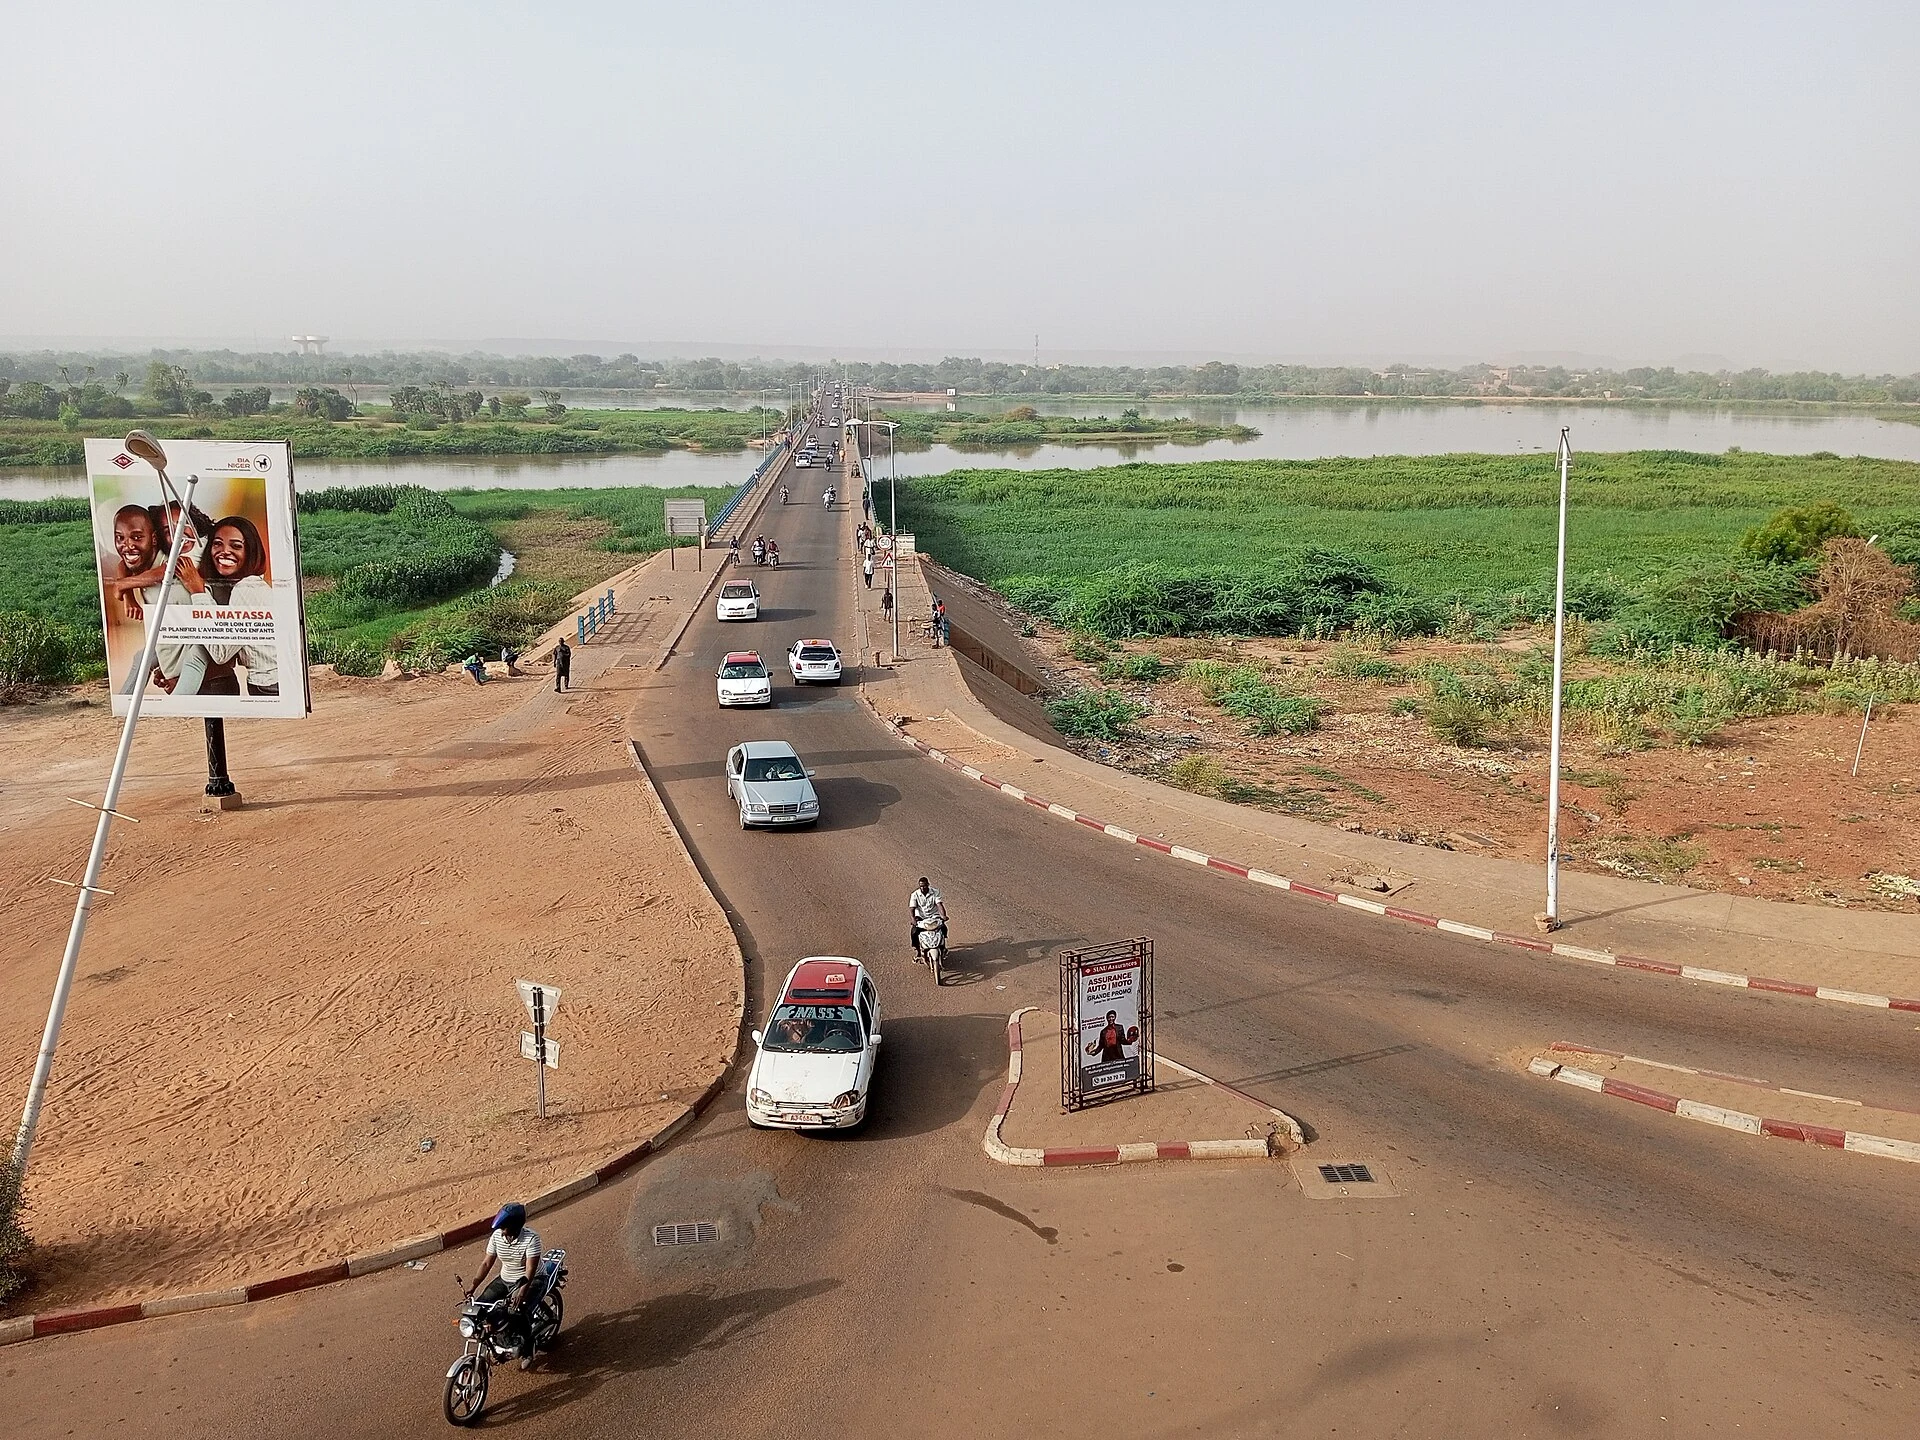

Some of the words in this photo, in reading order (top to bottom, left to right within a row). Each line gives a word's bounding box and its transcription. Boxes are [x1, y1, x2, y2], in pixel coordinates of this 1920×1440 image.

[192, 610, 212, 619] BIA
[216, 610, 273, 620] MATASSA
[1087, 984, 1106, 993] AUTO
[1112, 979, 1132, 988] MOTO
[1088, 972, 1132, 986] ASSURANCE
[1087, 992, 1110, 1002] GRANDE
[1111, 988, 1132, 996] PROMO
